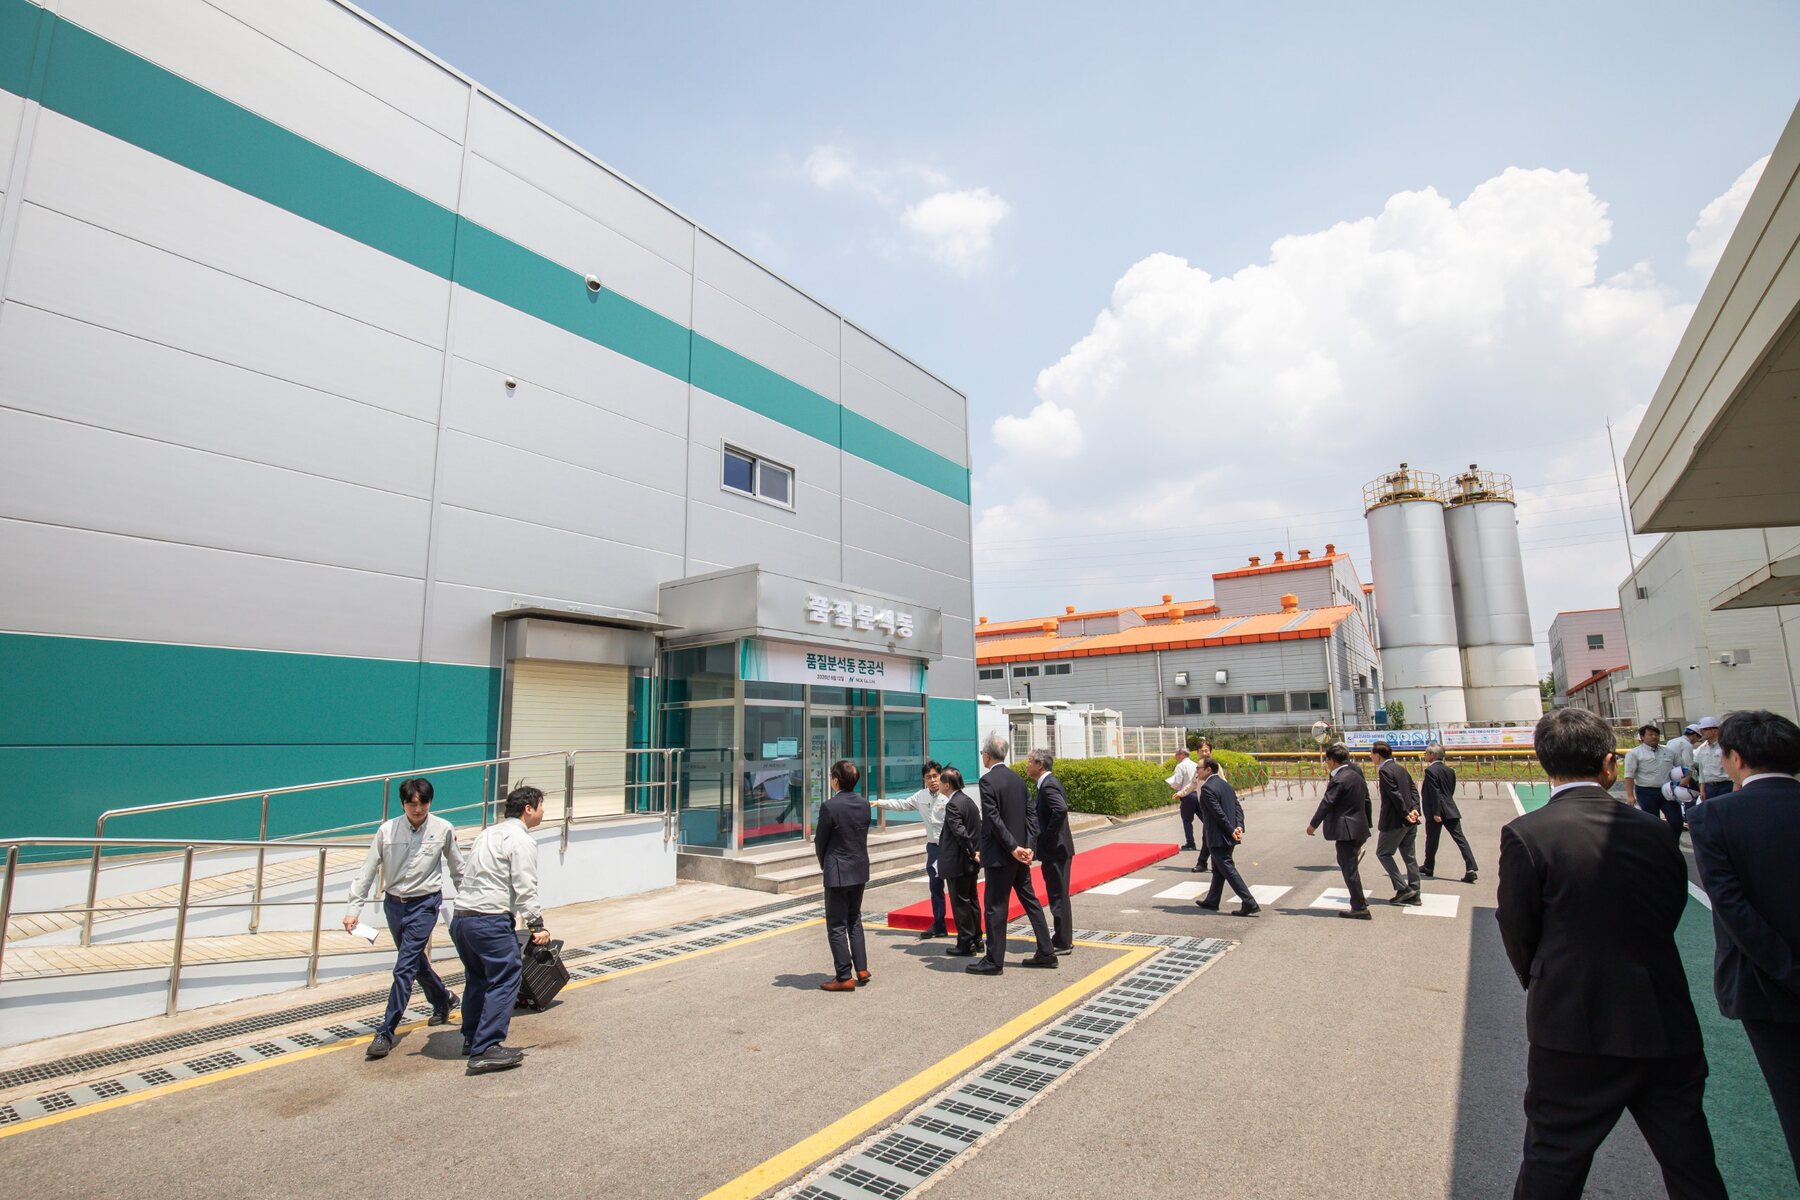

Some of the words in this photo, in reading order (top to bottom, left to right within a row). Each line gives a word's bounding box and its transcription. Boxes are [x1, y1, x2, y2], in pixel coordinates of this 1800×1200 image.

[807, 595, 913, 637] 품질분석동
[806, 653, 855, 673] 품질분석동
[858, 659, 885, 676] 준공식
